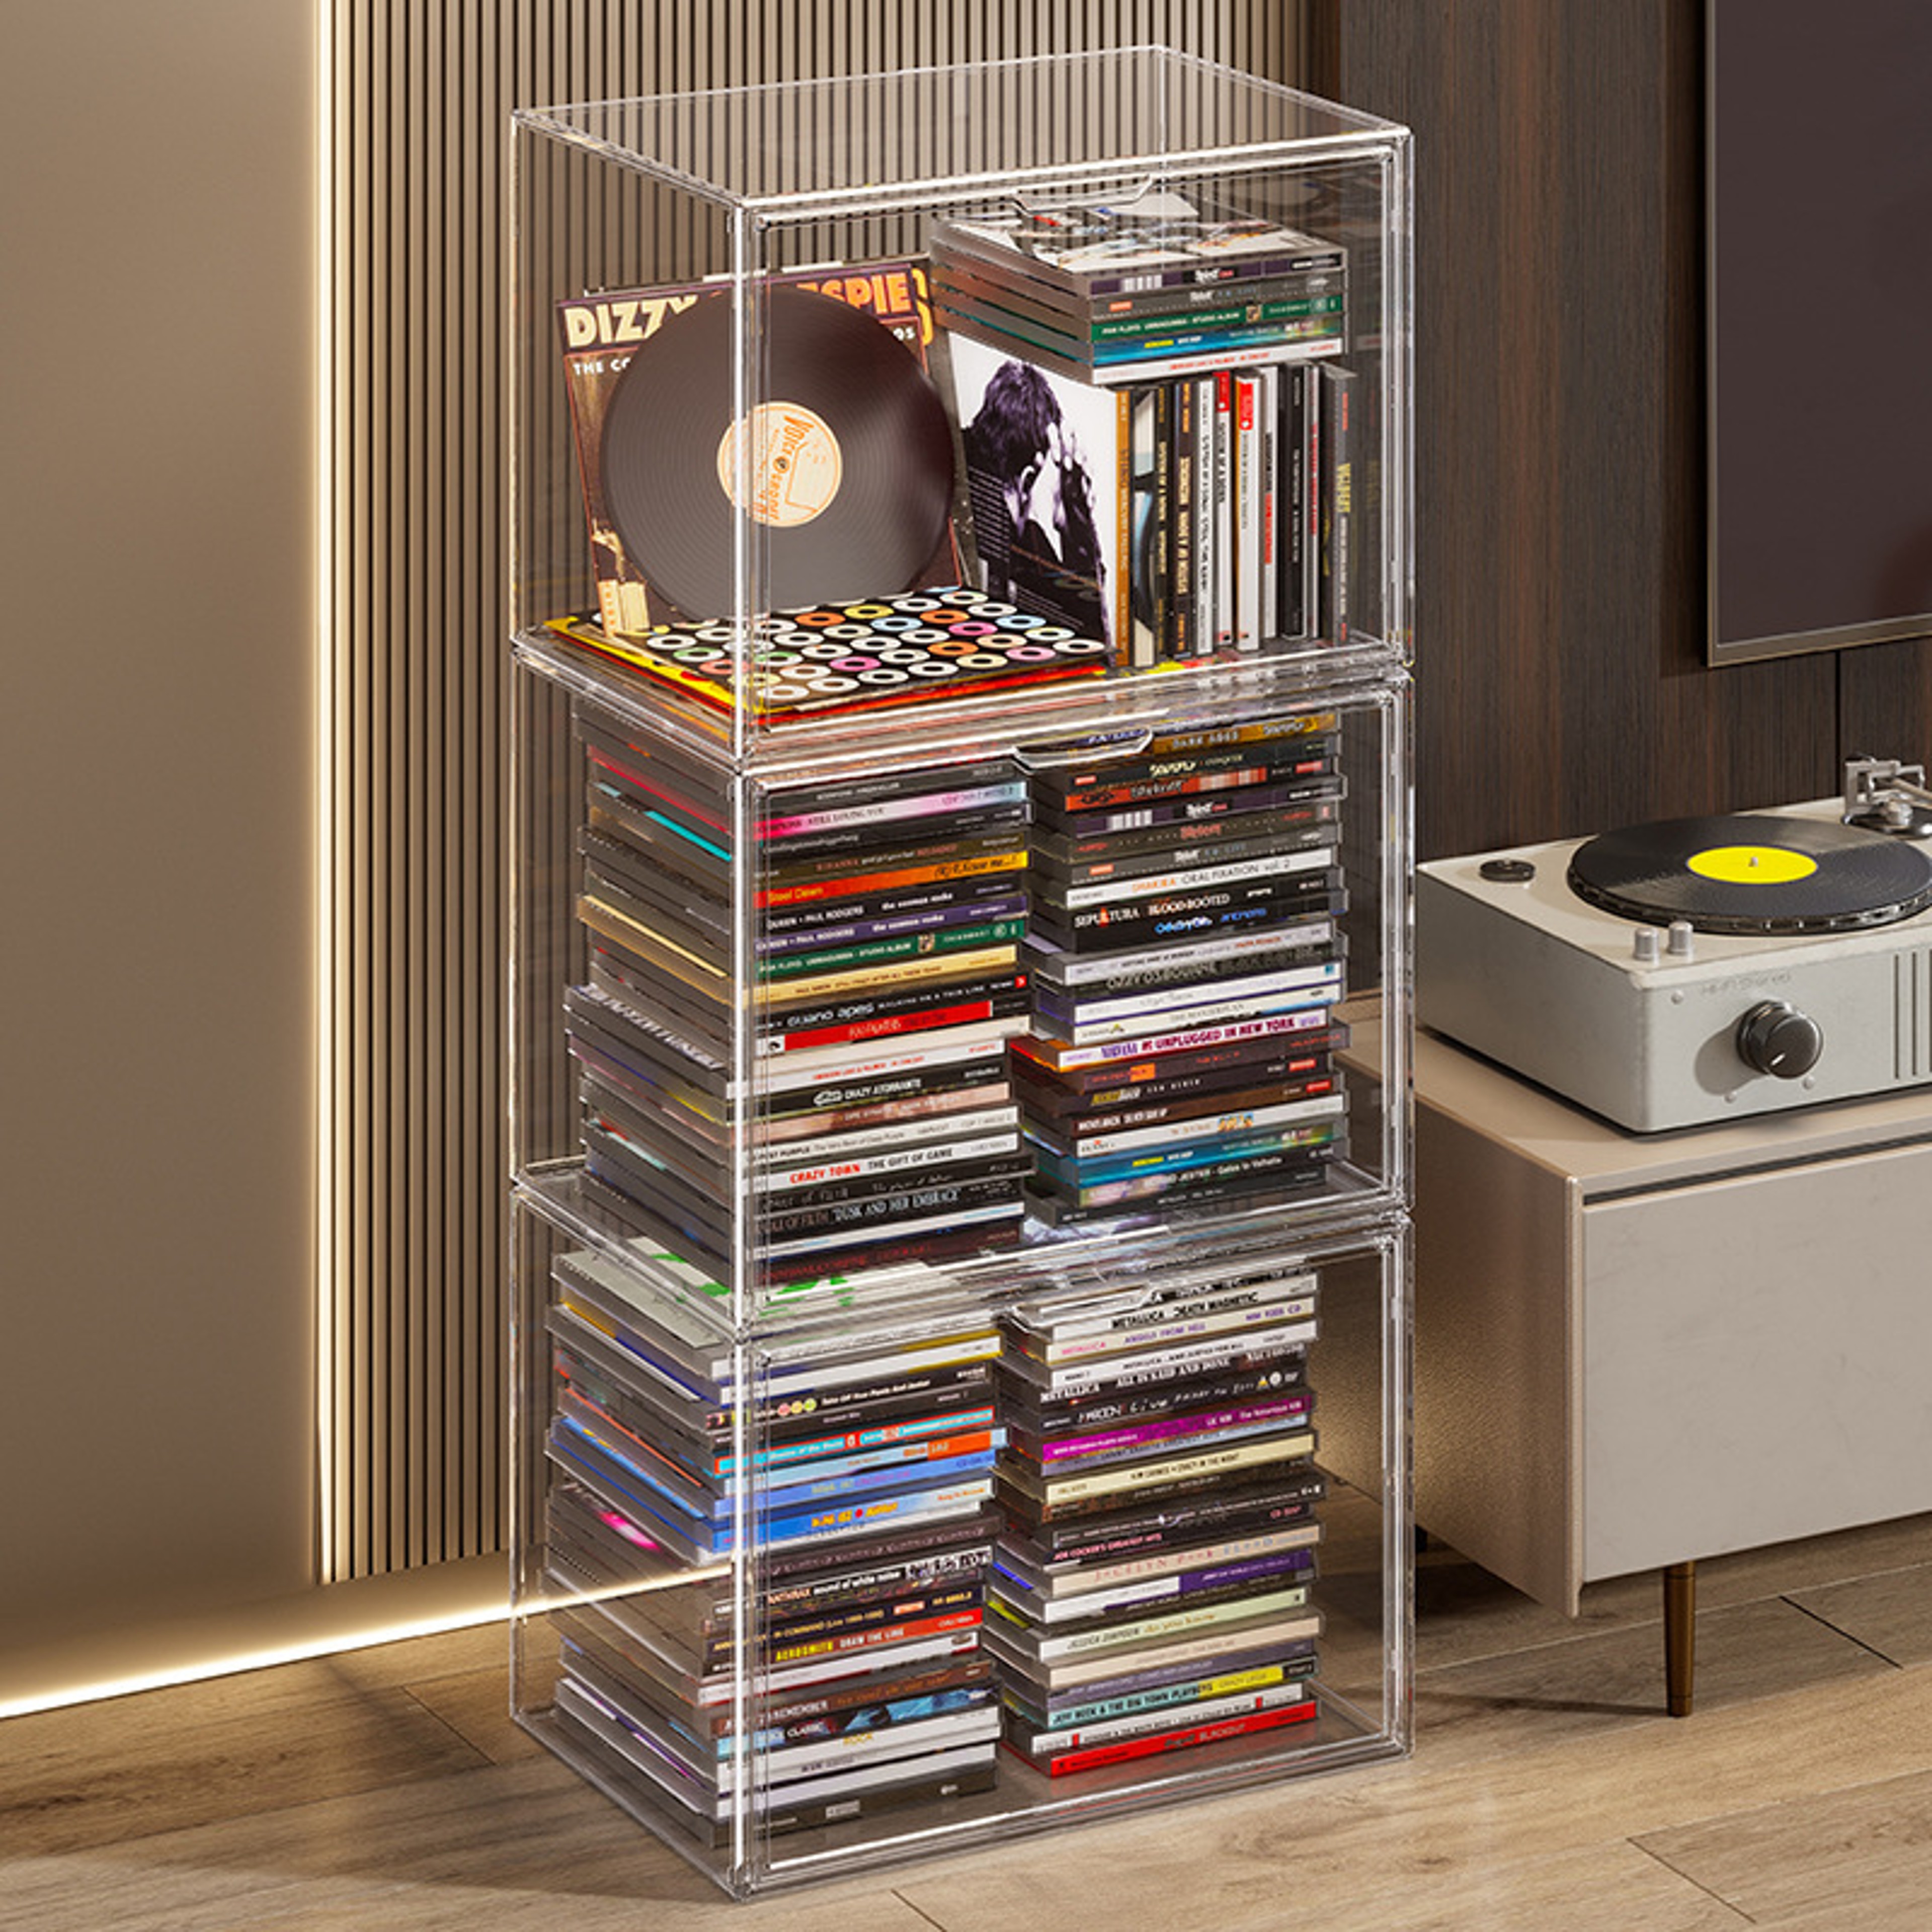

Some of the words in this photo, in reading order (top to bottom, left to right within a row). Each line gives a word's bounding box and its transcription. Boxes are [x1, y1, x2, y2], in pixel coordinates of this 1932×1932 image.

[573, 362, 604, 375] THE
[1180, 871, 1209, 886] ORAL
[1225, 1025, 1236, 1038] IN
[1239, 1022, 1262, 1035] NEW
[1266, 1016, 1295, 1032] YORK
[790, 1170, 826, 1184] CRAZY
[830, 1163, 860, 1177] TOWN
[867, 1160, 885, 1170] THE
[889, 1156, 908, 1167] GIFT
[911, 1154, 924, 1163] OF
[927, 1149, 952, 1160] GAME
[1111, 1310, 1165, 1330] METALLICA
[775, 1641, 834, 1662] AEROSMITH
[839, 1635, 864, 1648] DRAW
[867, 1632, 882, 1643] THE
[885, 1628, 904, 1640] LINE
[1053, 1711, 1072, 1724] JEFF
[1109, 1701, 1124, 1712] THE
